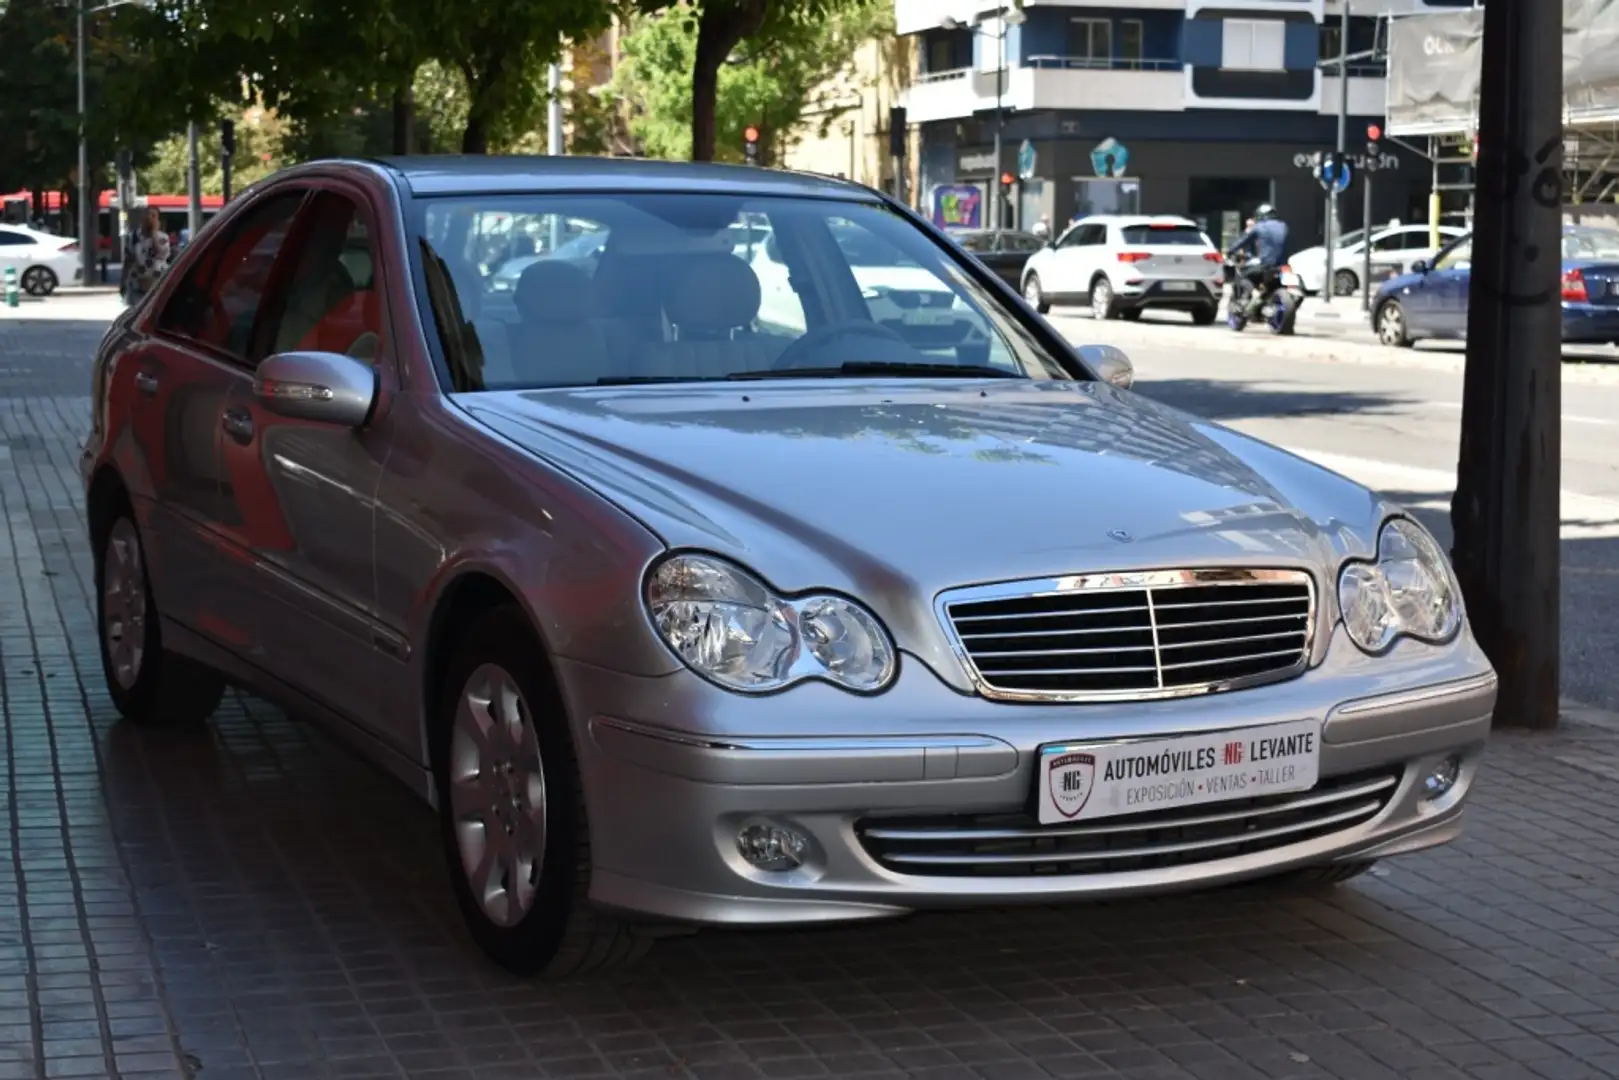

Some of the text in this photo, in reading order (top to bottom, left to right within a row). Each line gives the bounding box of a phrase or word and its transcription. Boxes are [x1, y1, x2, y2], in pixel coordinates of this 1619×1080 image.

[1103, 747, 1216, 782] AUTOMÓVILES
[1223, 741, 1243, 766] NG
[1250, 732, 1314, 762] LEVANTE
[1063, 770, 1081, 792] NG
[1126, 764, 1296, 805] EXPOSICIÓN VENTAS TALLER
